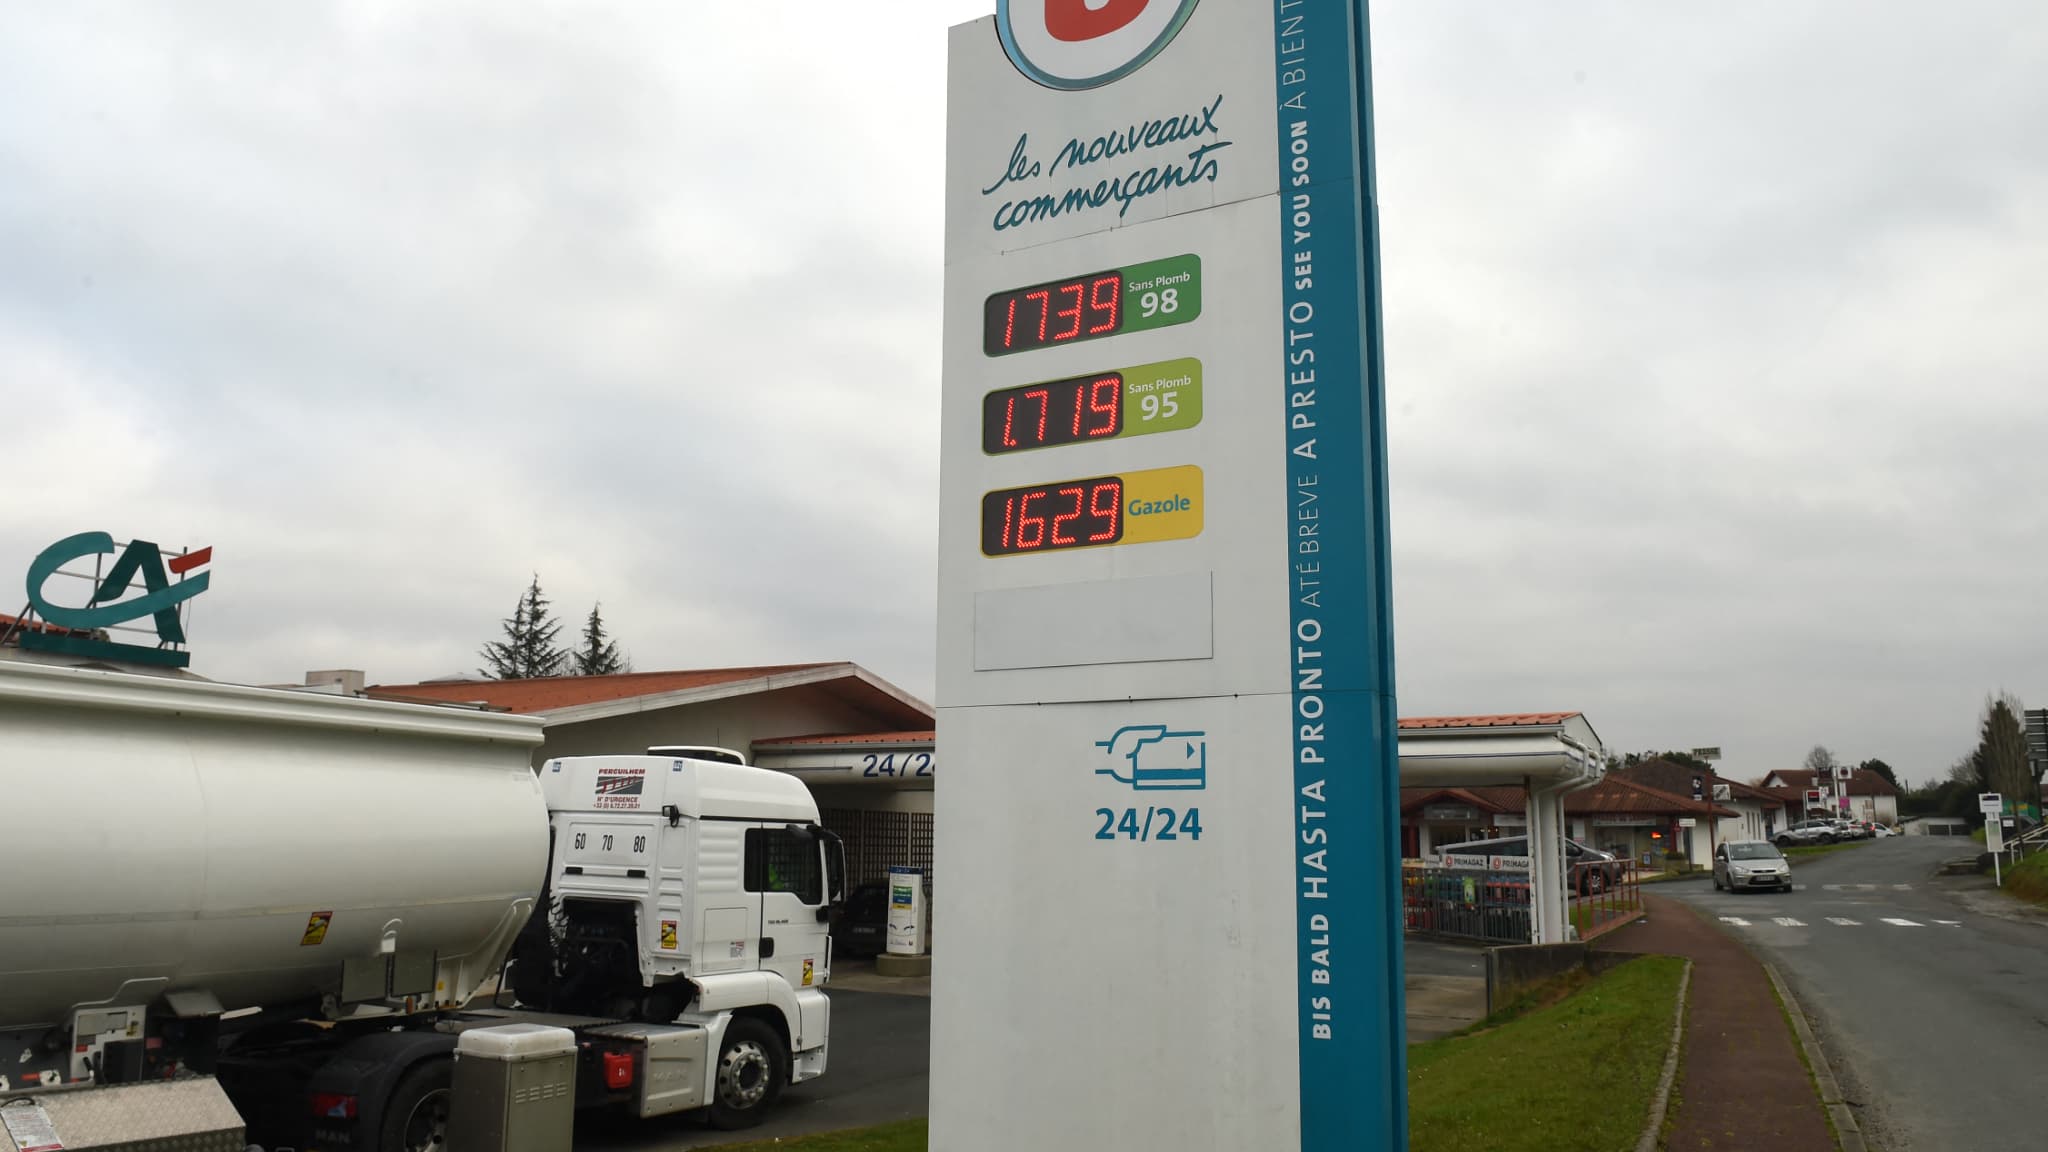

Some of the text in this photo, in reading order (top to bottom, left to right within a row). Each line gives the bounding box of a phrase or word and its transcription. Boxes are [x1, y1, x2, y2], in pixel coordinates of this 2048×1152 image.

[982, 94, 1223, 195] les nouveaux
[993, 141, 1233, 231] commerçants
[1290, 120, 1312, 290] SEE YOU SOON
[1128, 271, 1191, 293] Sans Plomb
[1140, 288, 1179, 318] 98
[1128, 375, 1192, 394] Sans Plomb
[1289, 301, 1317, 460] A PRESTO
[1141, 391, 1179, 421] 95
[1002, 483, 1121, 548] 1629
[1128, 494, 1191, 516] Gazole
[1295, 474, 1321, 608] ATÉ BREVE
[863, 753, 935, 777] 24/2
[1297, 618, 1328, 899] HASTA PRONTO
[1095, 806, 1203, 842] 24/24
[574, 833, 586, 850] 60
[602, 835, 614, 851] 70
[633, 836, 646, 853] 80
[1454, 858, 1484, 867] PRIMAGAZ
[1503, 859, 1529, 868] PRIMAGA
[1310, 913, 1332, 1040] BIS BALD
